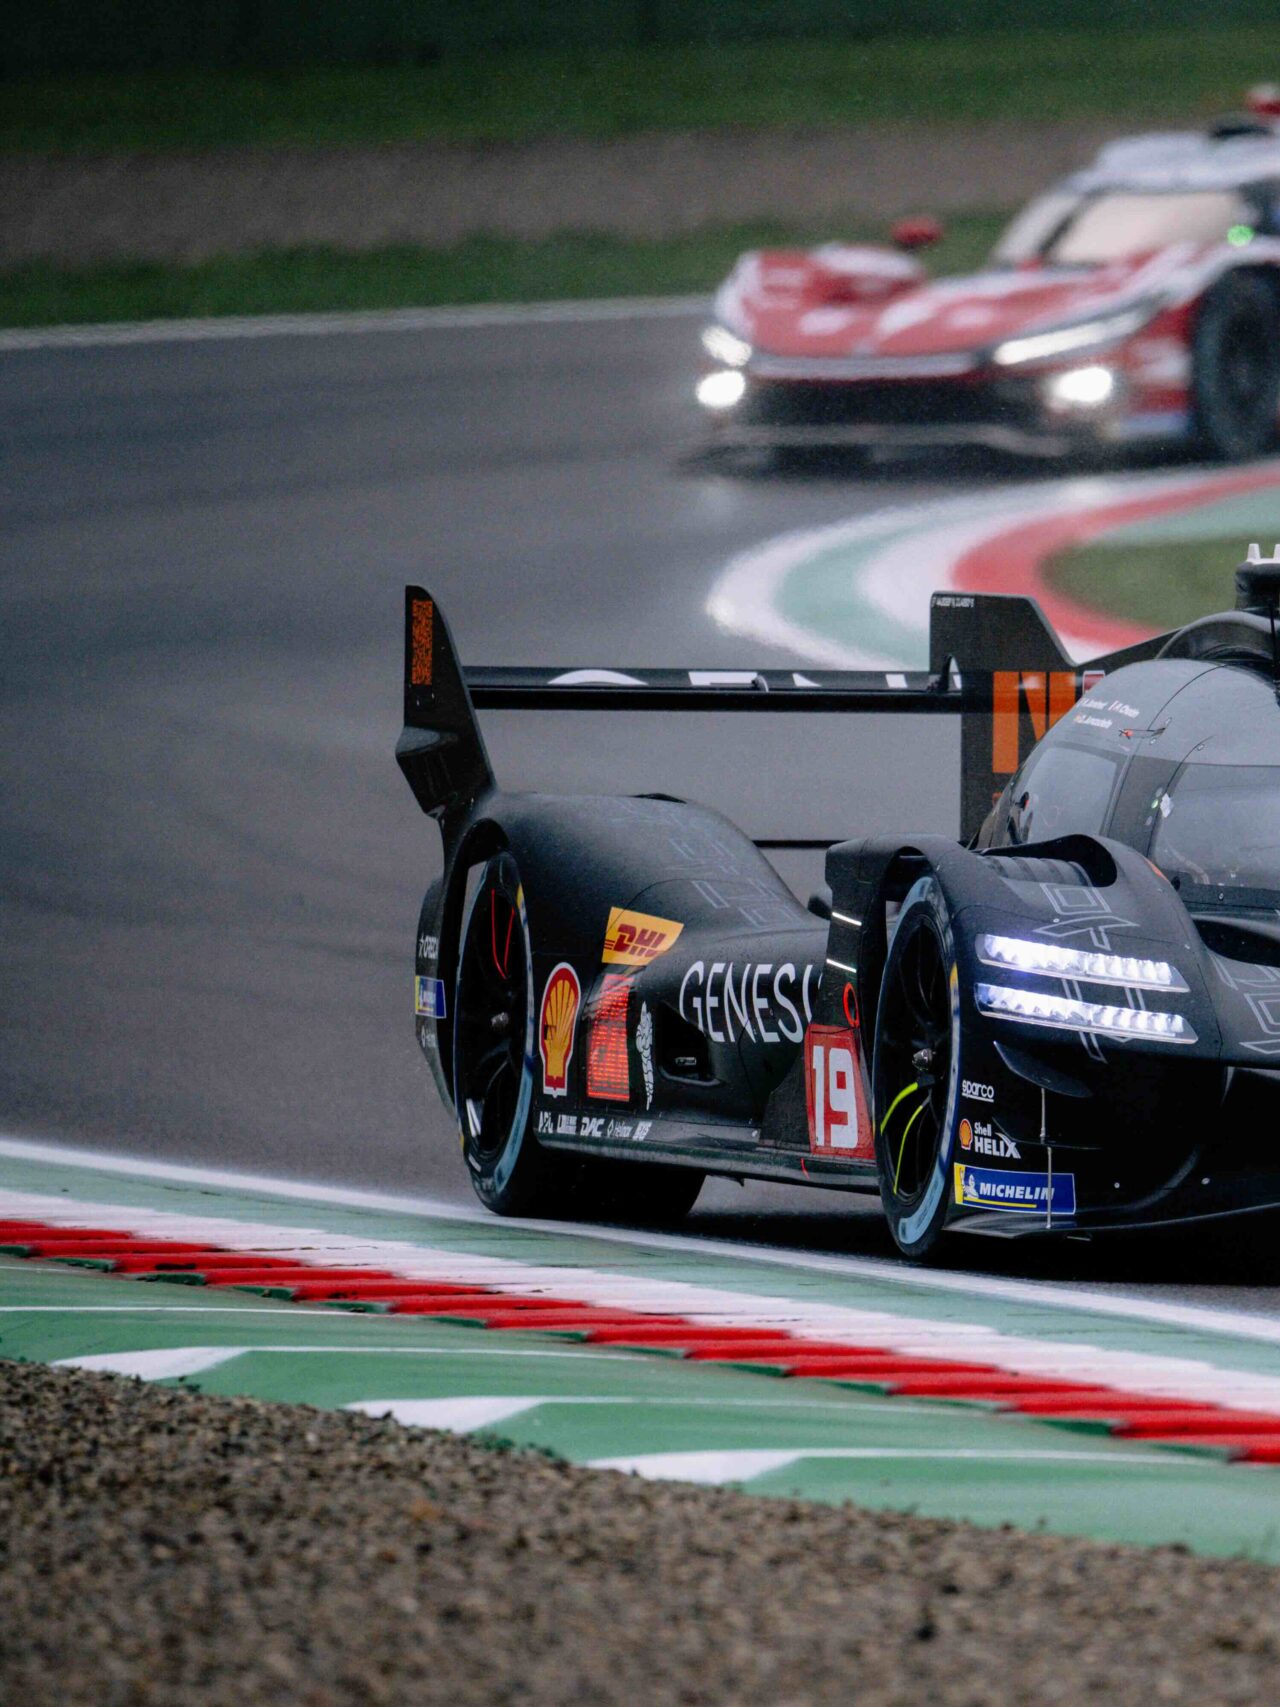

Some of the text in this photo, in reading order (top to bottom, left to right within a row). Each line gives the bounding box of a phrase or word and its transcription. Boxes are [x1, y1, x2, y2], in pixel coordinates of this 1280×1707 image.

[613, 923, 667, 957] DHL
[679, 961, 823, 1043] GENESI
[812, 1045, 858, 1148] 19
[962, 1080, 994, 1098] sparco
[974, 1122, 992, 1136] Shell
[974, 1132, 1021, 1159] HELIX
[979, 1182, 1055, 1200] MICHELIN
